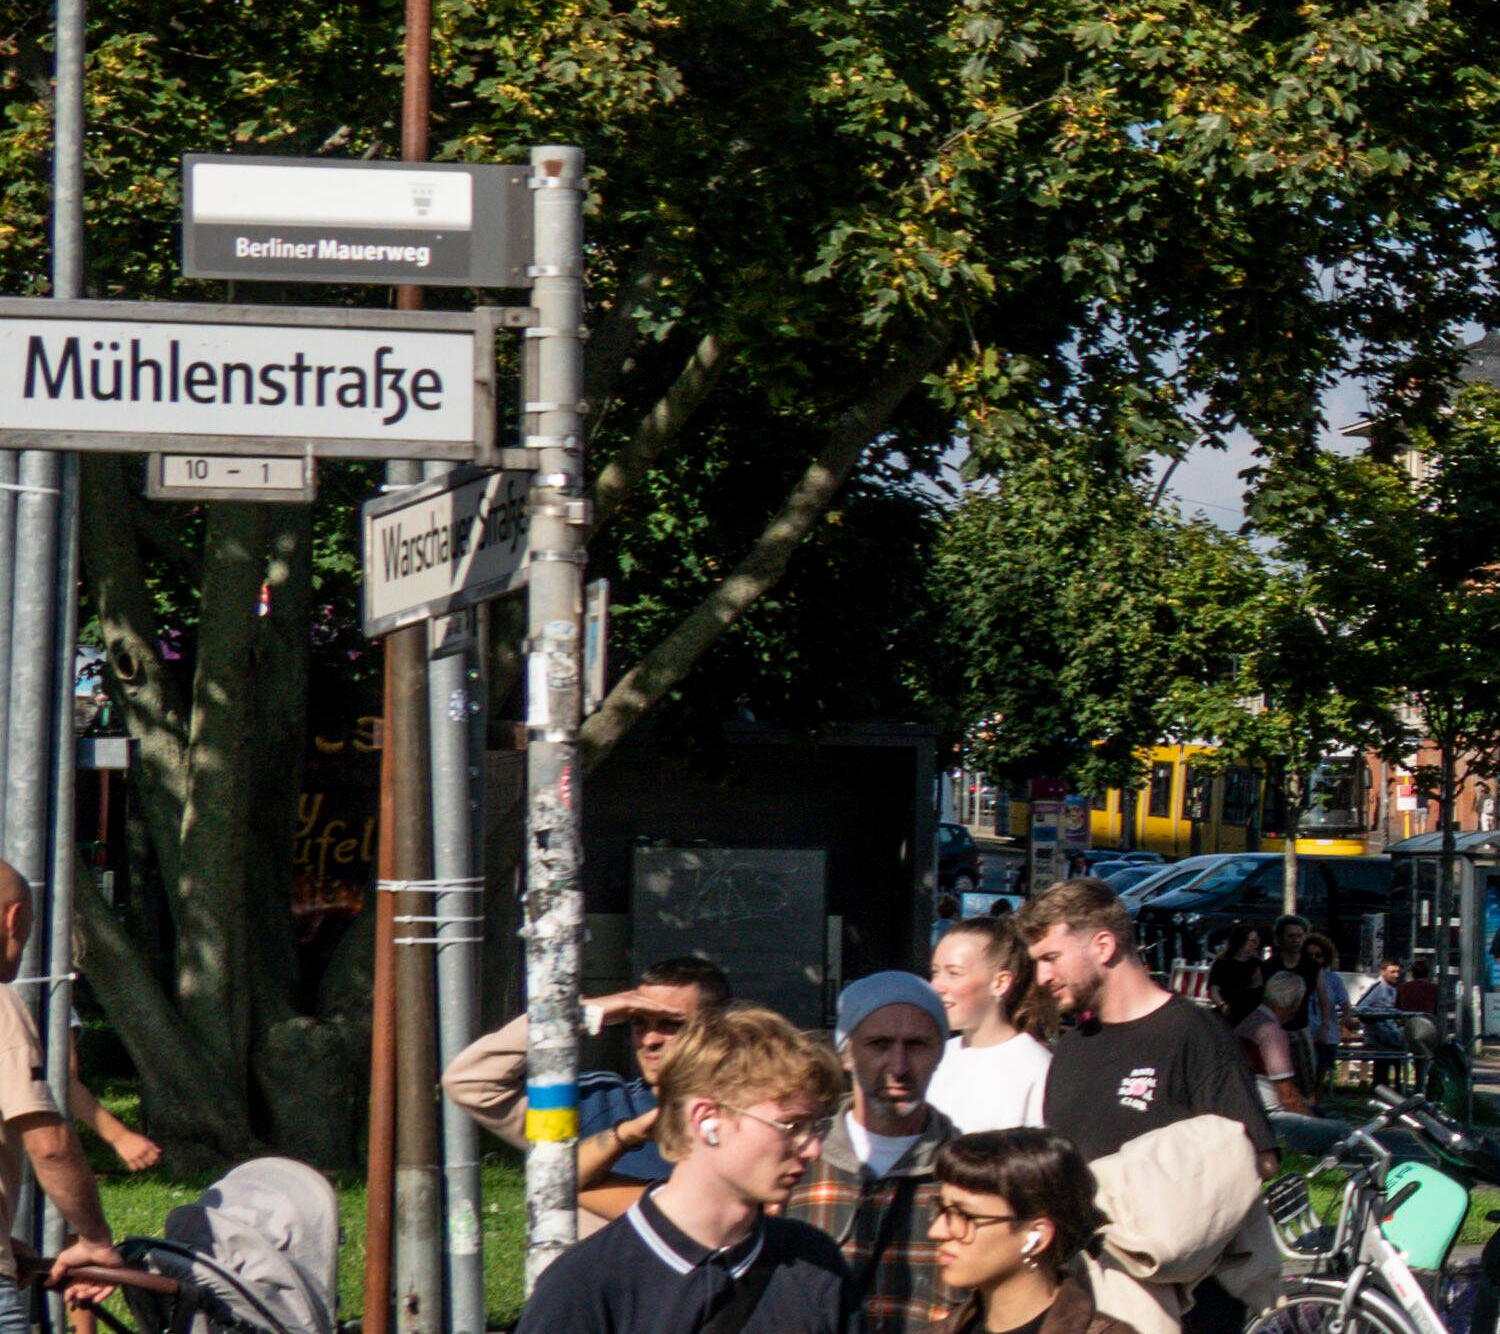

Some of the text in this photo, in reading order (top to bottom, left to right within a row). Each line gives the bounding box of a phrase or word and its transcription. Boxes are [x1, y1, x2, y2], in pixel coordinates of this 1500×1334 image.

[235, 237, 431, 266] Berliner Mauerweg
[24, 336, 444, 426] Mühlenstraße
[184, 458, 208, 481] 10
[382, 510, 471, 583] Warschauer
